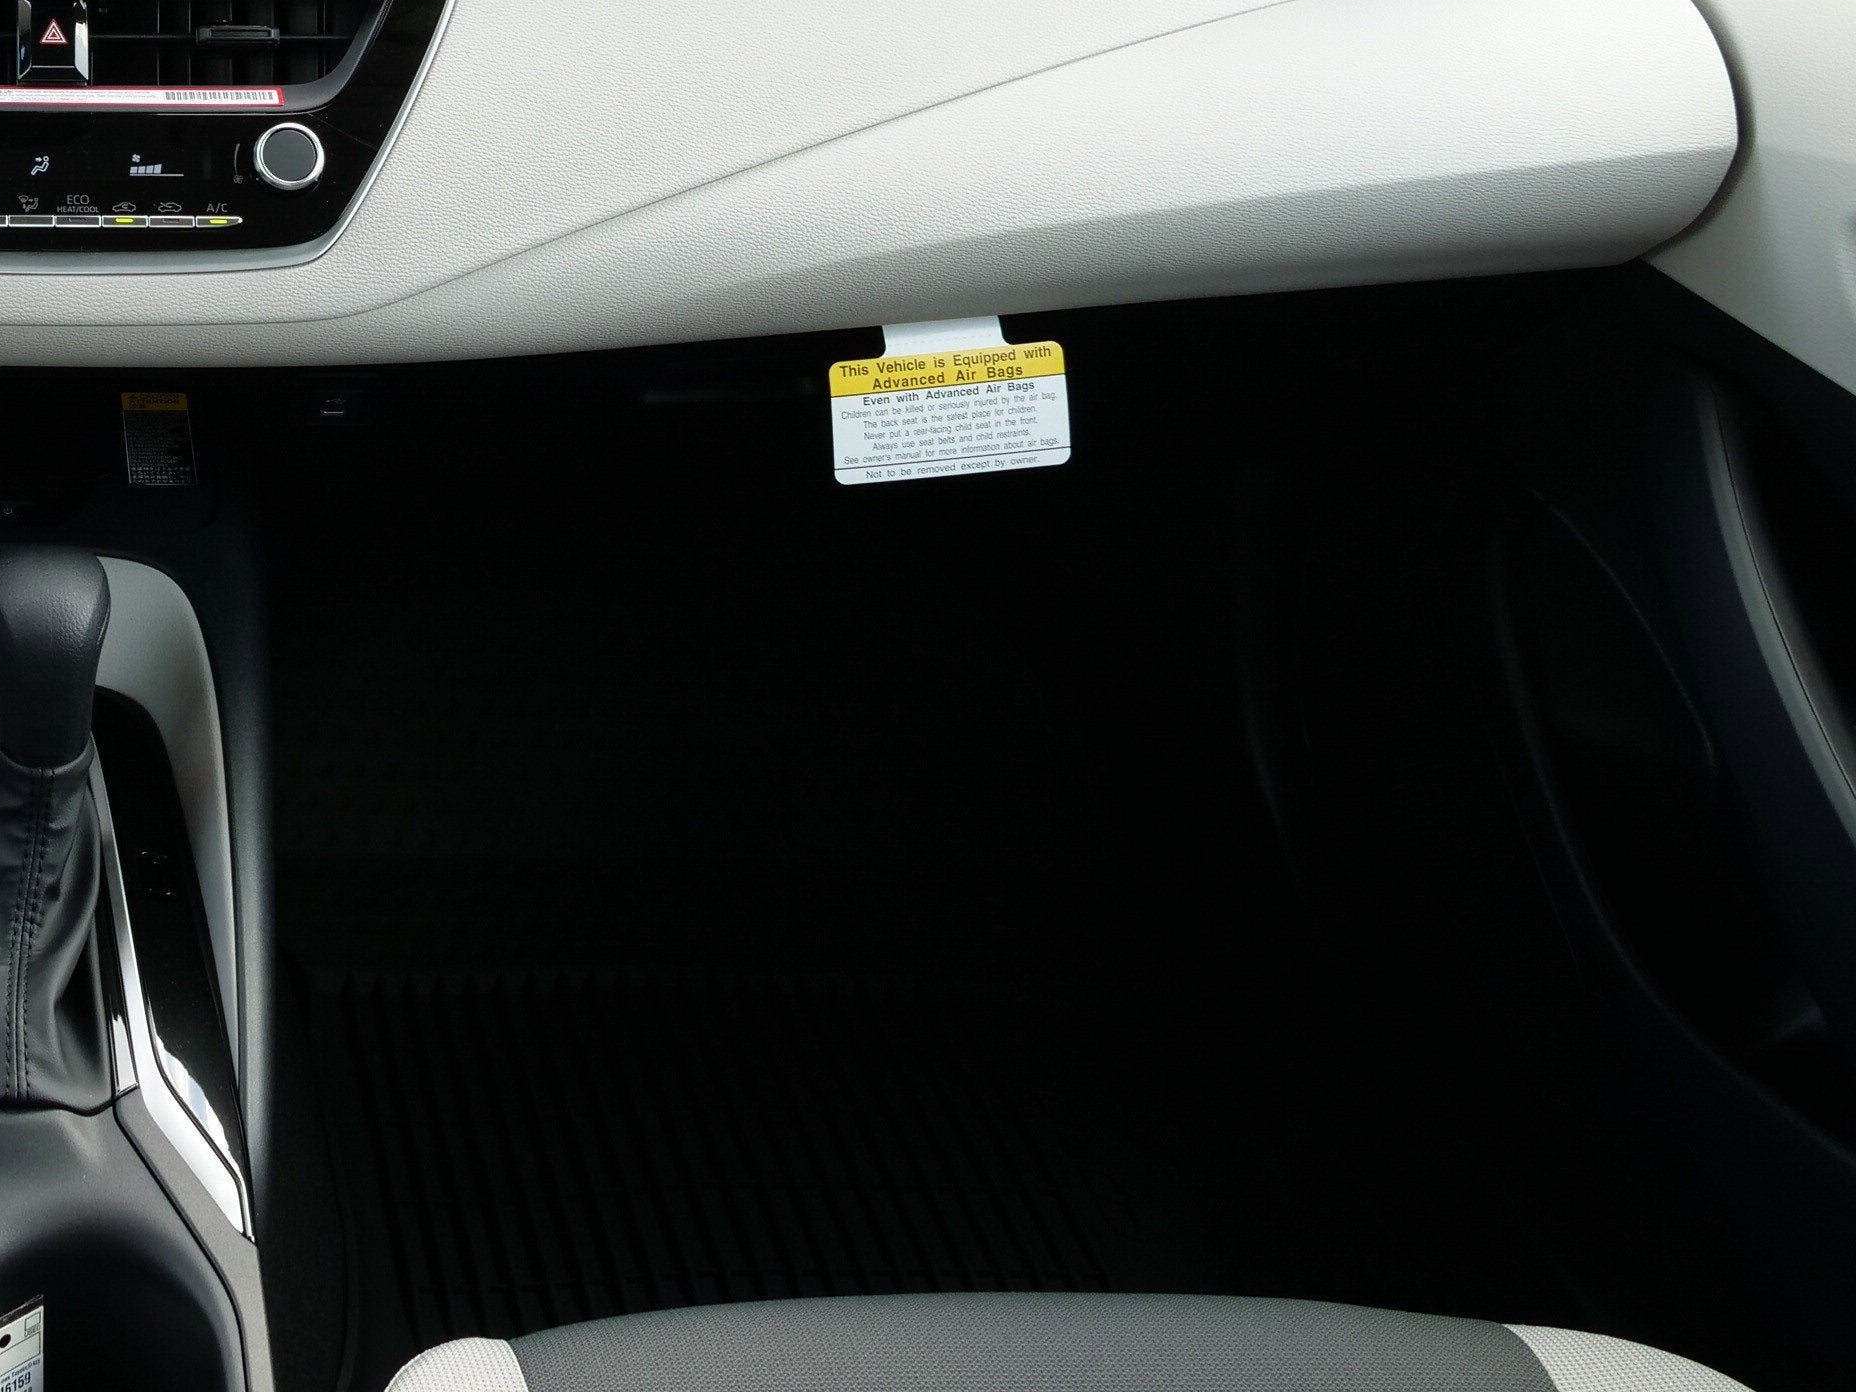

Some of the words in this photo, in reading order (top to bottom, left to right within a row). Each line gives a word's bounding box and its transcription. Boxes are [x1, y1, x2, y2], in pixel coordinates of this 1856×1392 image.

[56, 205, 100, 213] HEAT/COOL
[66, 194, 90, 205] ECO
[206, 203, 228, 213] A/C
[839, 363, 868, 377] This
[876, 358, 926, 373] Vehicle
[933, 356, 945, 367] is
[953, 349, 1016, 368] Equipped
[1023, 345, 1051, 358] with
[871, 371, 945, 389] Advanced
[955, 368, 976, 381] Air
[986, 364, 1023, 380] Bags
[841, 409, 871, 419] Children
[874, 407, 888, 416] can
[891, 406, 901, 414] be
[905, 403, 924, 413] killed
[927, 402, 935, 411] or
[938, 399, 969, 412] seriously
[973, 396, 998, 408] injured
[1001, 395, 1010, 405] by
[1013, 394, 1025, 402] the
[1028, 392, 1038, 401] air
[1041, 391, 1056, 401] bag.
[862, 394, 889, 405] Even
[896, 391, 919, 402] with
[924, 386, 978, 399] Advanced
[985, 383, 1001, 393] Air
[1007, 380, 1035, 393] Bags
[865, 469, 882, 479] Not
[886, 468, 896, 477] to
[899, 467, 911, 476] be
[917, 462, 956, 474] removed
[959, 459, 990, 471] except
[993, 457, 1005, 468] by
[1009, 454, 1040, 465] owner.
